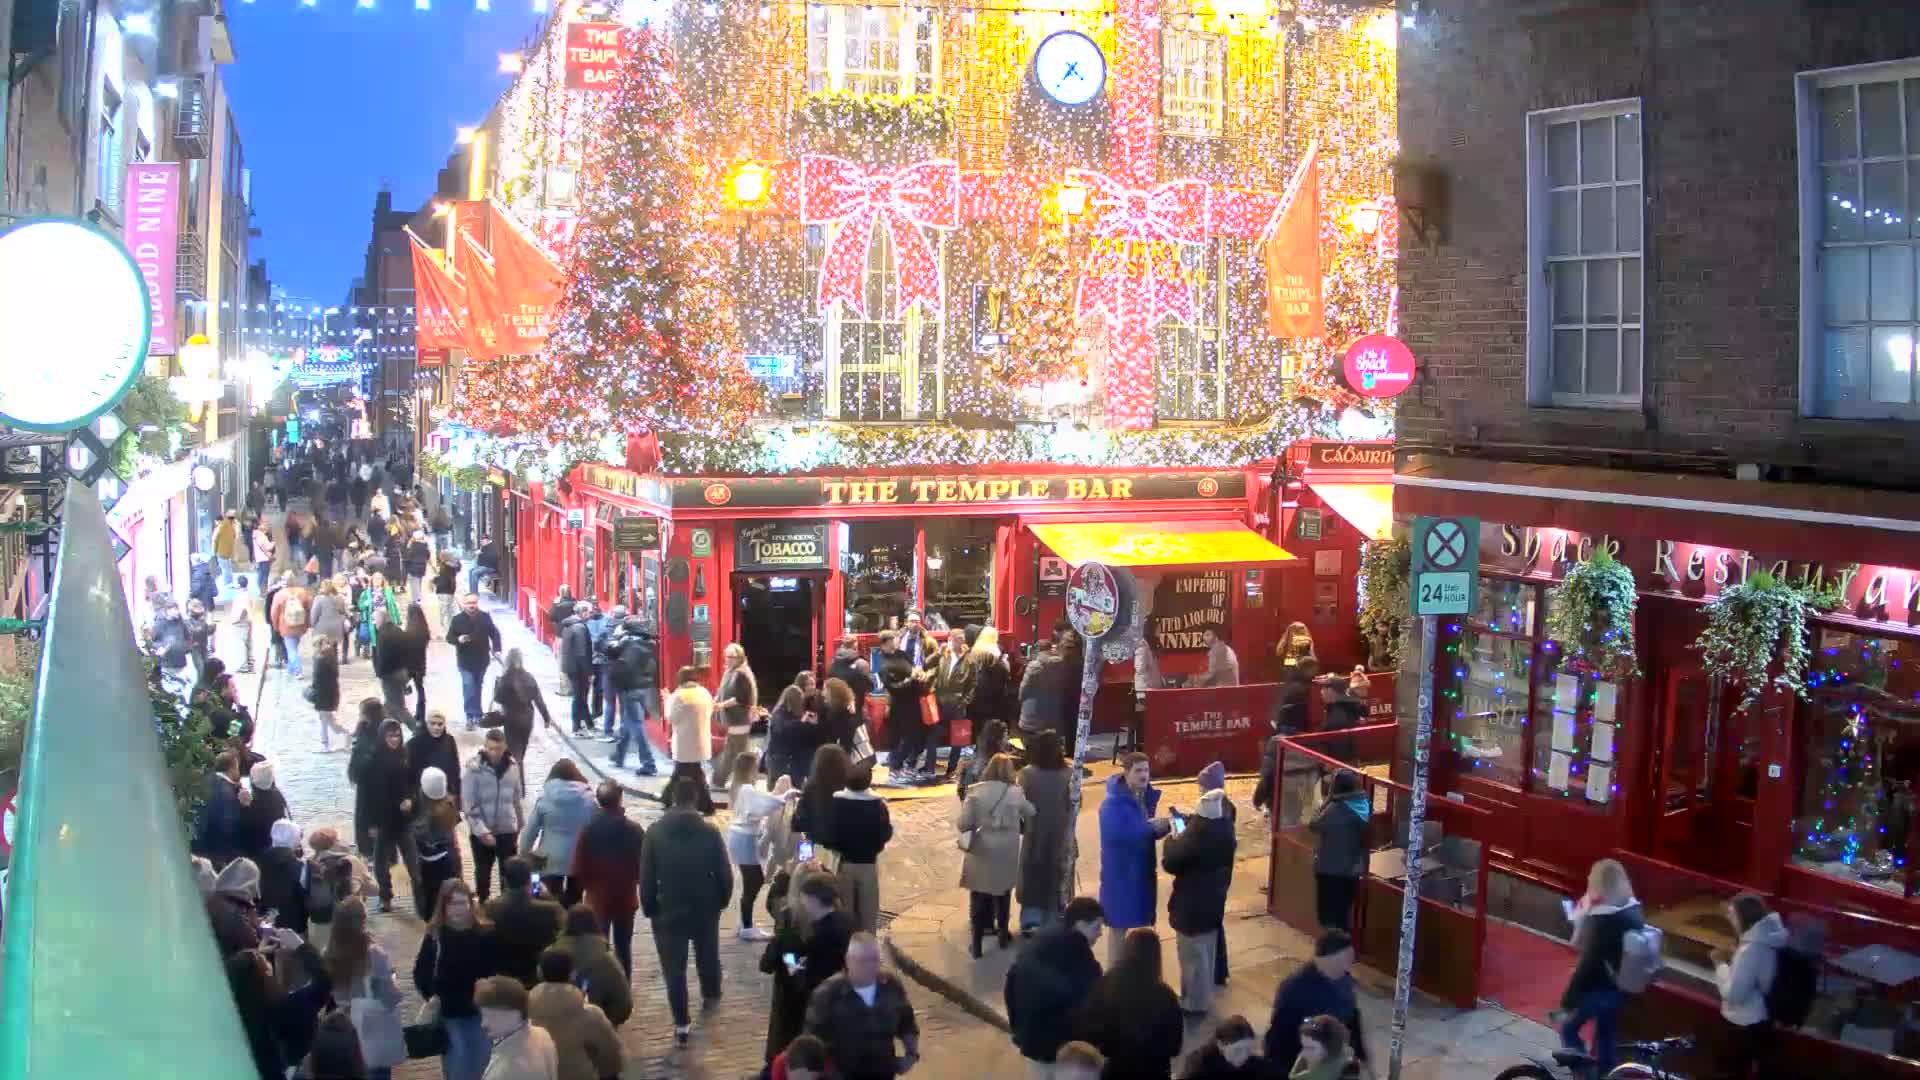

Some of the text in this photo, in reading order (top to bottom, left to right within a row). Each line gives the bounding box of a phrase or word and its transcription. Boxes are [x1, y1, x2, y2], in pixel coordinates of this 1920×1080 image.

[584, 29, 618, 46] THE
[136, 171, 169, 232] NINE
[519, 304, 545, 314] THE
[823, 477, 1133, 504] THE TEMPLE BAR
[1199, 480, 1215, 493] 48
[1176, 578, 1226, 593] EMPEROR
[1422, 584, 1443, 603] 24
[1211, 593, 1225, 607] OF
[1370, 703, 1392, 715] BAR
[1174, 716, 1250, 733] TEMPLE BAR
